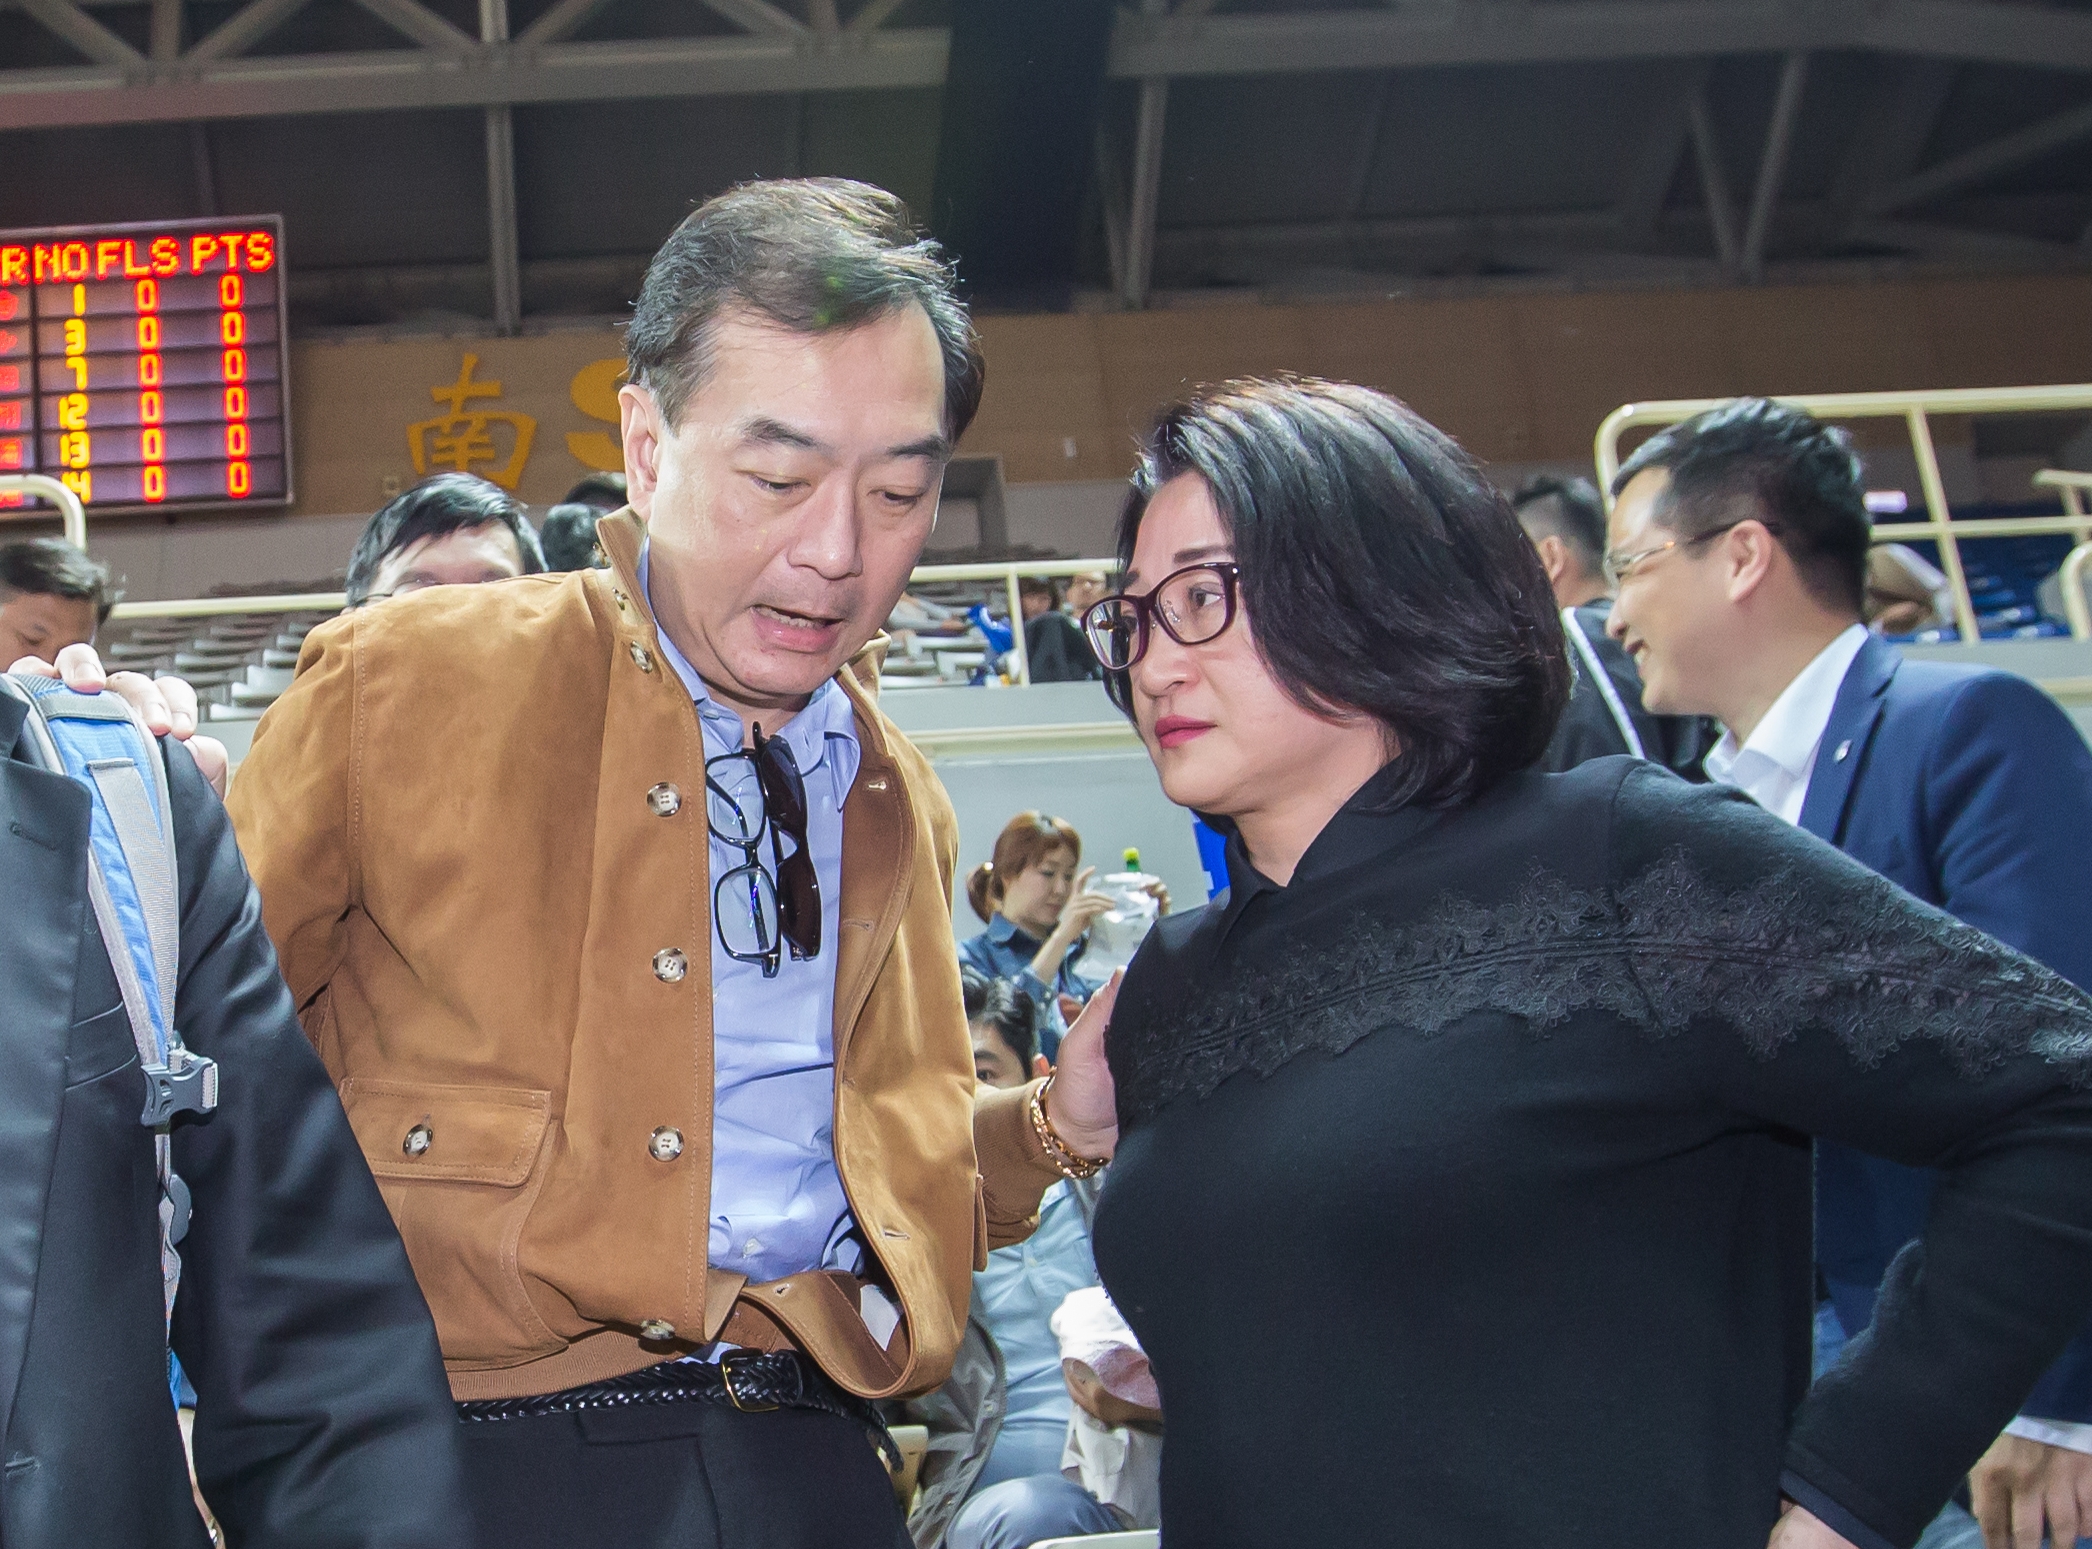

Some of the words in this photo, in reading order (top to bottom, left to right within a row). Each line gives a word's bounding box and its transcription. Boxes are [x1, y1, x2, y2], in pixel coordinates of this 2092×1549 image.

[33, 241, 91, 284] NO
[96, 236, 181, 280] FLS
[190, 231, 275, 275] PTS
[73, 283, 86, 316] 1
[135, 278, 159, 314] 0
[219, 272, 244, 311] 0
[64, 319, 86, 356] 3
[137, 316, 162, 352] 0
[220, 311, 245, 348] 0
[66, 356, 88, 390] 7
[138, 352, 163, 389] 0
[222, 348, 247, 385] 0
[59, 393, 89, 430] 12
[139, 389, 164, 426] 0
[224, 385, 249, 422] 0
[406, 353, 537, 489] 南
[60, 431, 90, 468] 13
[141, 426, 165, 463] 0
[225, 422, 250, 459] 0
[143, 463, 167, 503] 0
[227, 459, 252, 498] 0
